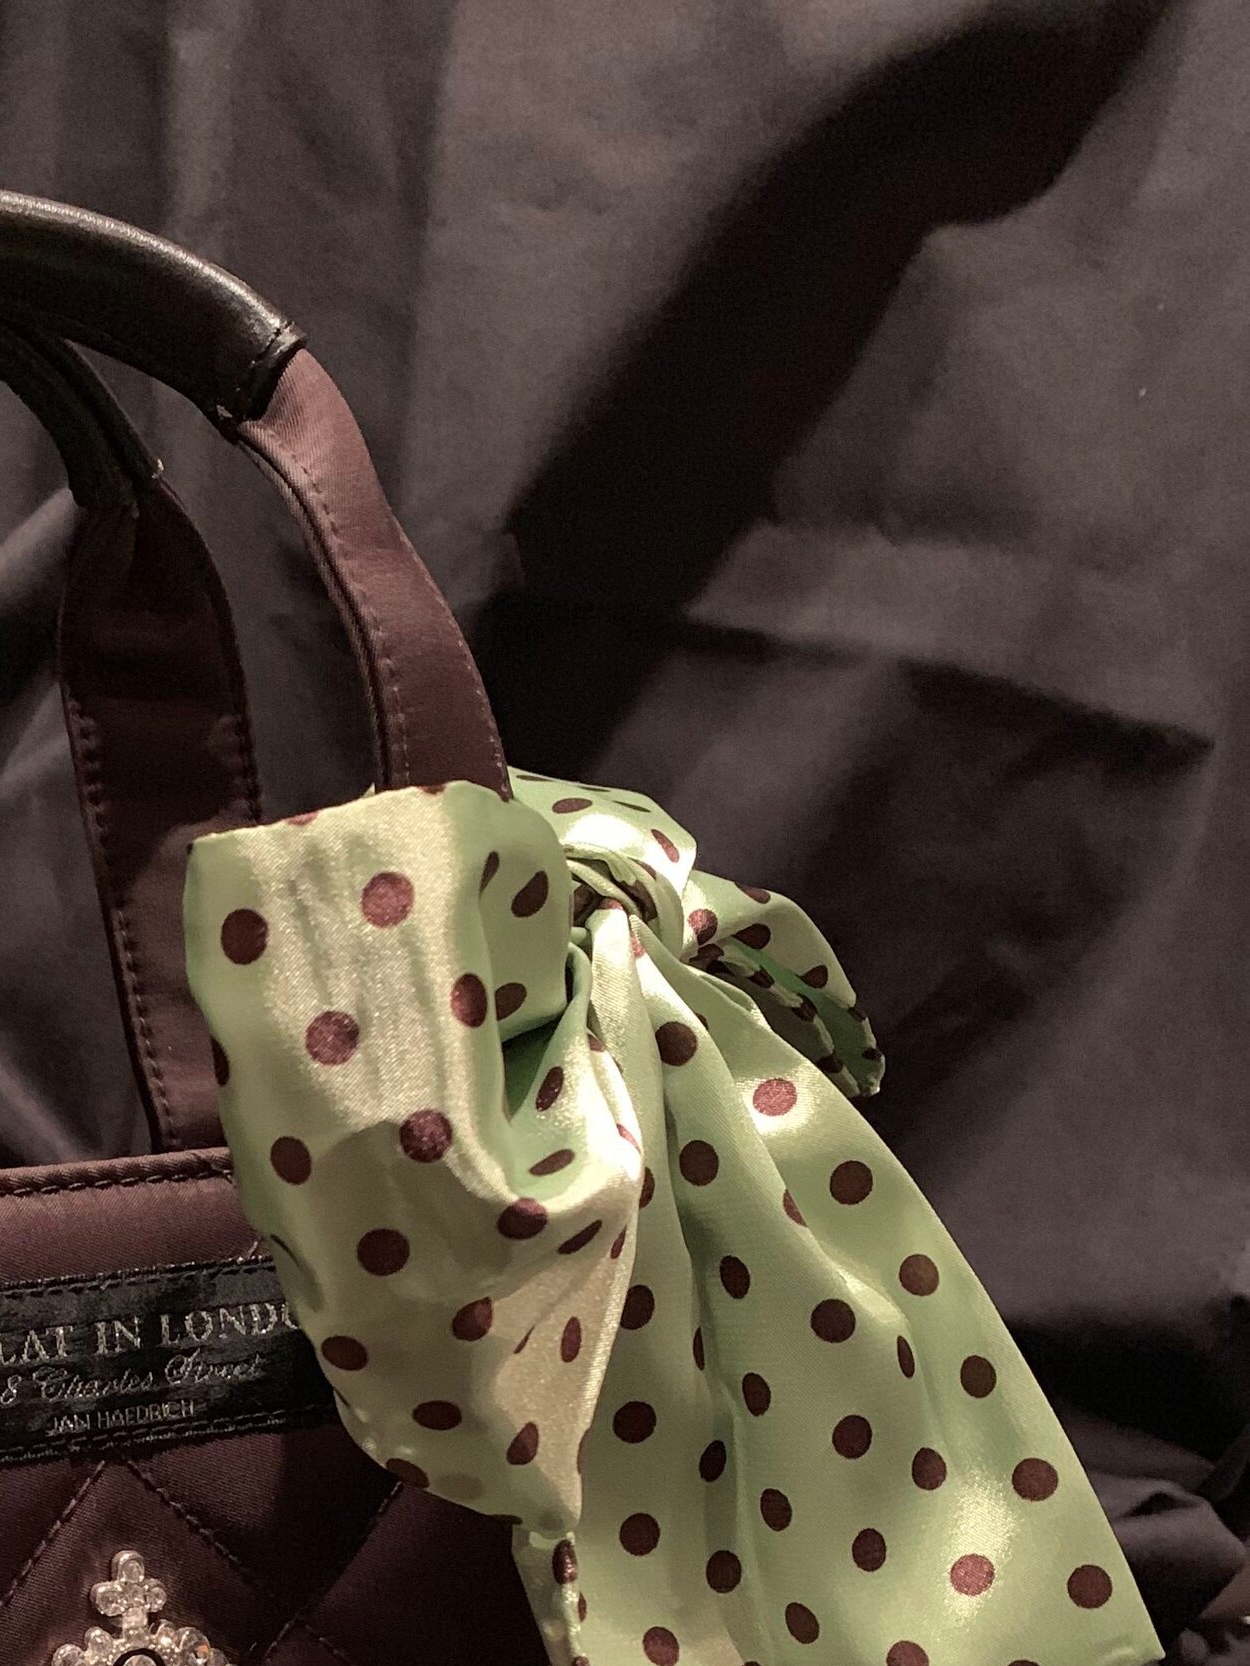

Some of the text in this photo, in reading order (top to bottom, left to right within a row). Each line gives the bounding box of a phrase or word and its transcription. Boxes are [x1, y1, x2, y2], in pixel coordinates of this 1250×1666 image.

[95, 1315, 142, 1355] IN
[32, 1366, 154, 1402] Charles
[164, 1348, 268, 1385] Street
[97, 1399, 195, 1430] HAEDRICH
